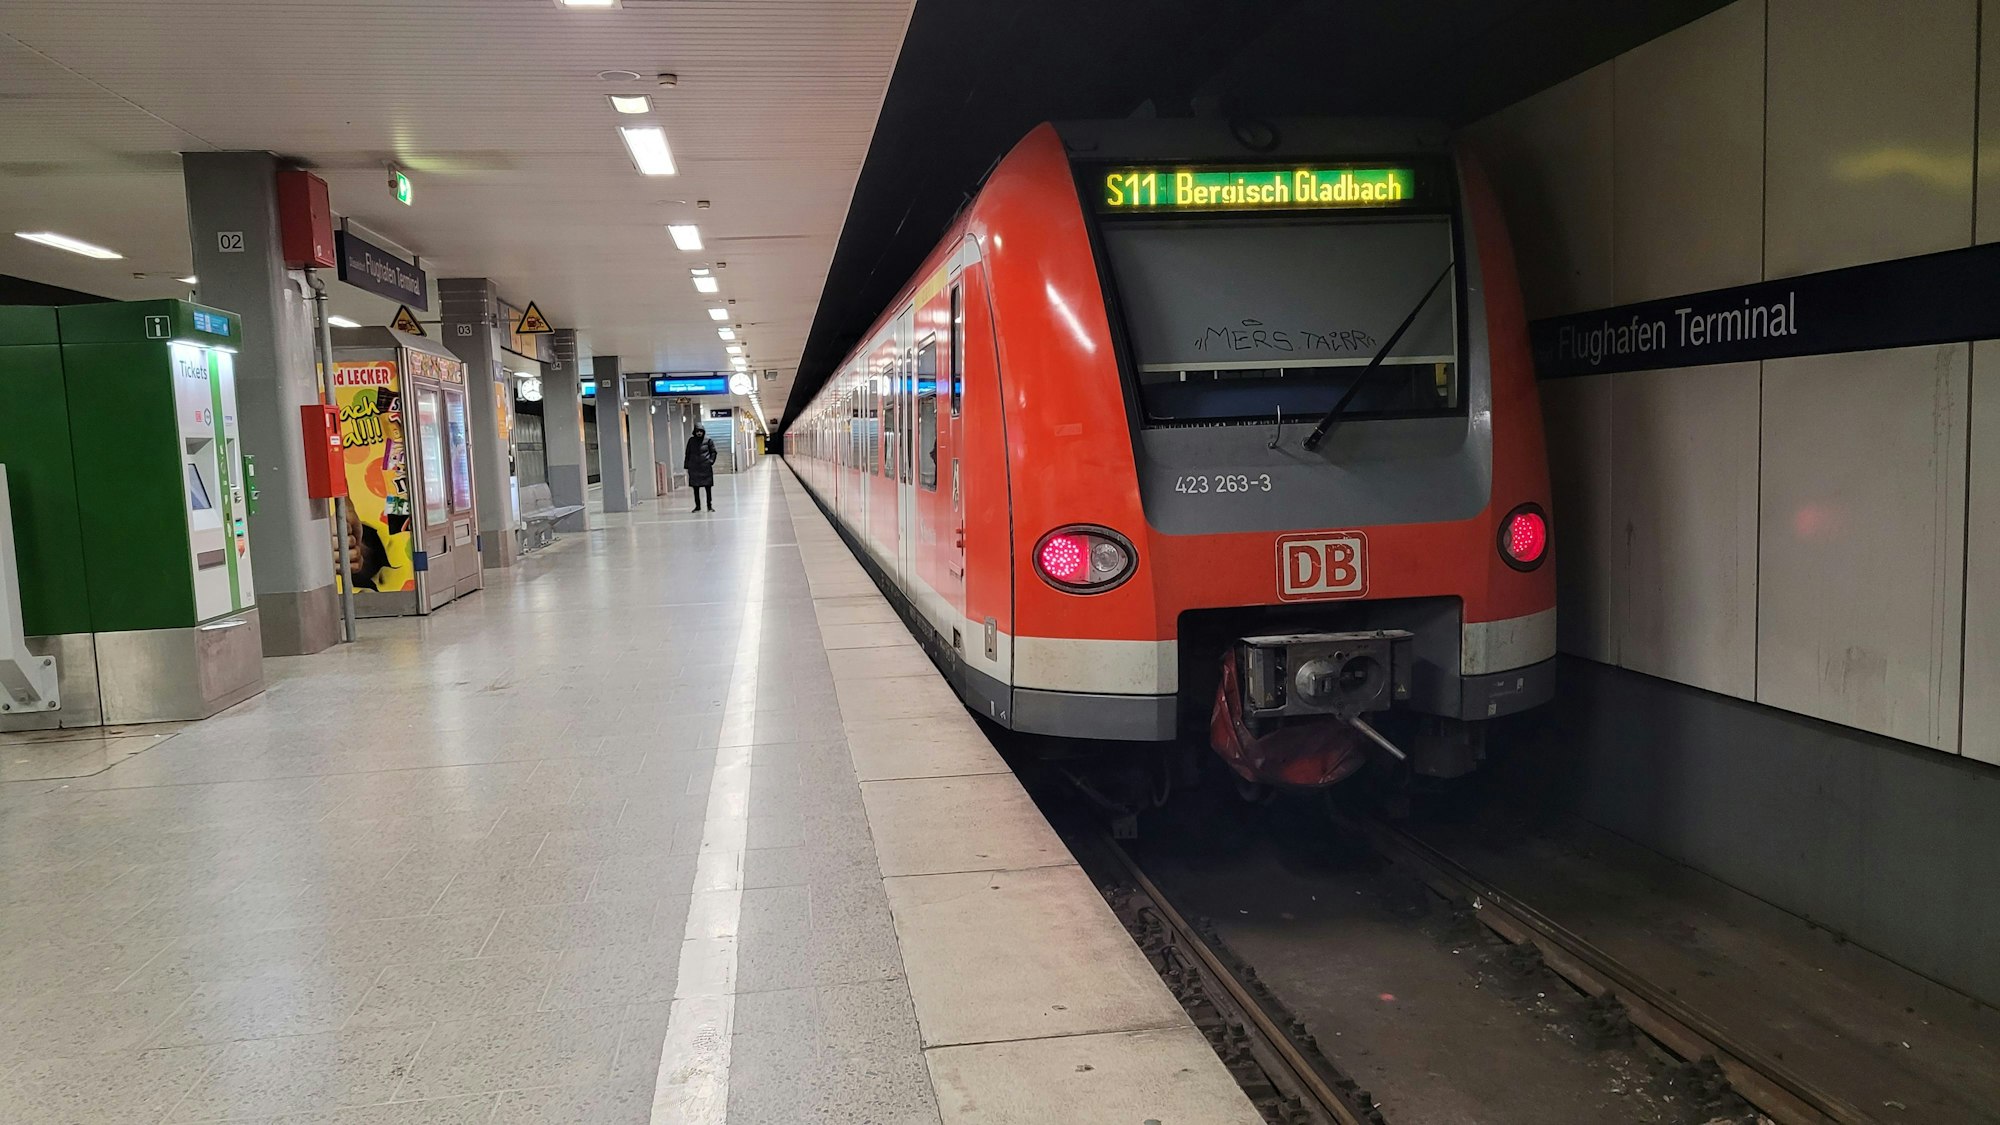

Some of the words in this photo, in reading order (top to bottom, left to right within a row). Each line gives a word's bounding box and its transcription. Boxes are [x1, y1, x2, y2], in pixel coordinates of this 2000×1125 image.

[1105, 173, 1157, 207] S11
[1177, 171, 1289, 205] Bergisch
[1295, 169, 1402, 202] Gladbach
[220, 234, 242, 249] 02
[365, 252, 397, 286] Flughafen
[395, 266, 421, 296] Terminal
[458, 325, 471, 334] 03
[1558, 315, 1667, 367] Flughafen
[1674, 291, 1799, 348] Terminal
[179, 360, 208, 380] Tickets
[347, 368, 390, 386] LECKER
[1175, 475, 1209, 494] 423
[1214, 474, 1272, 493] 263-3
[1289, 543, 1357, 589] DB
